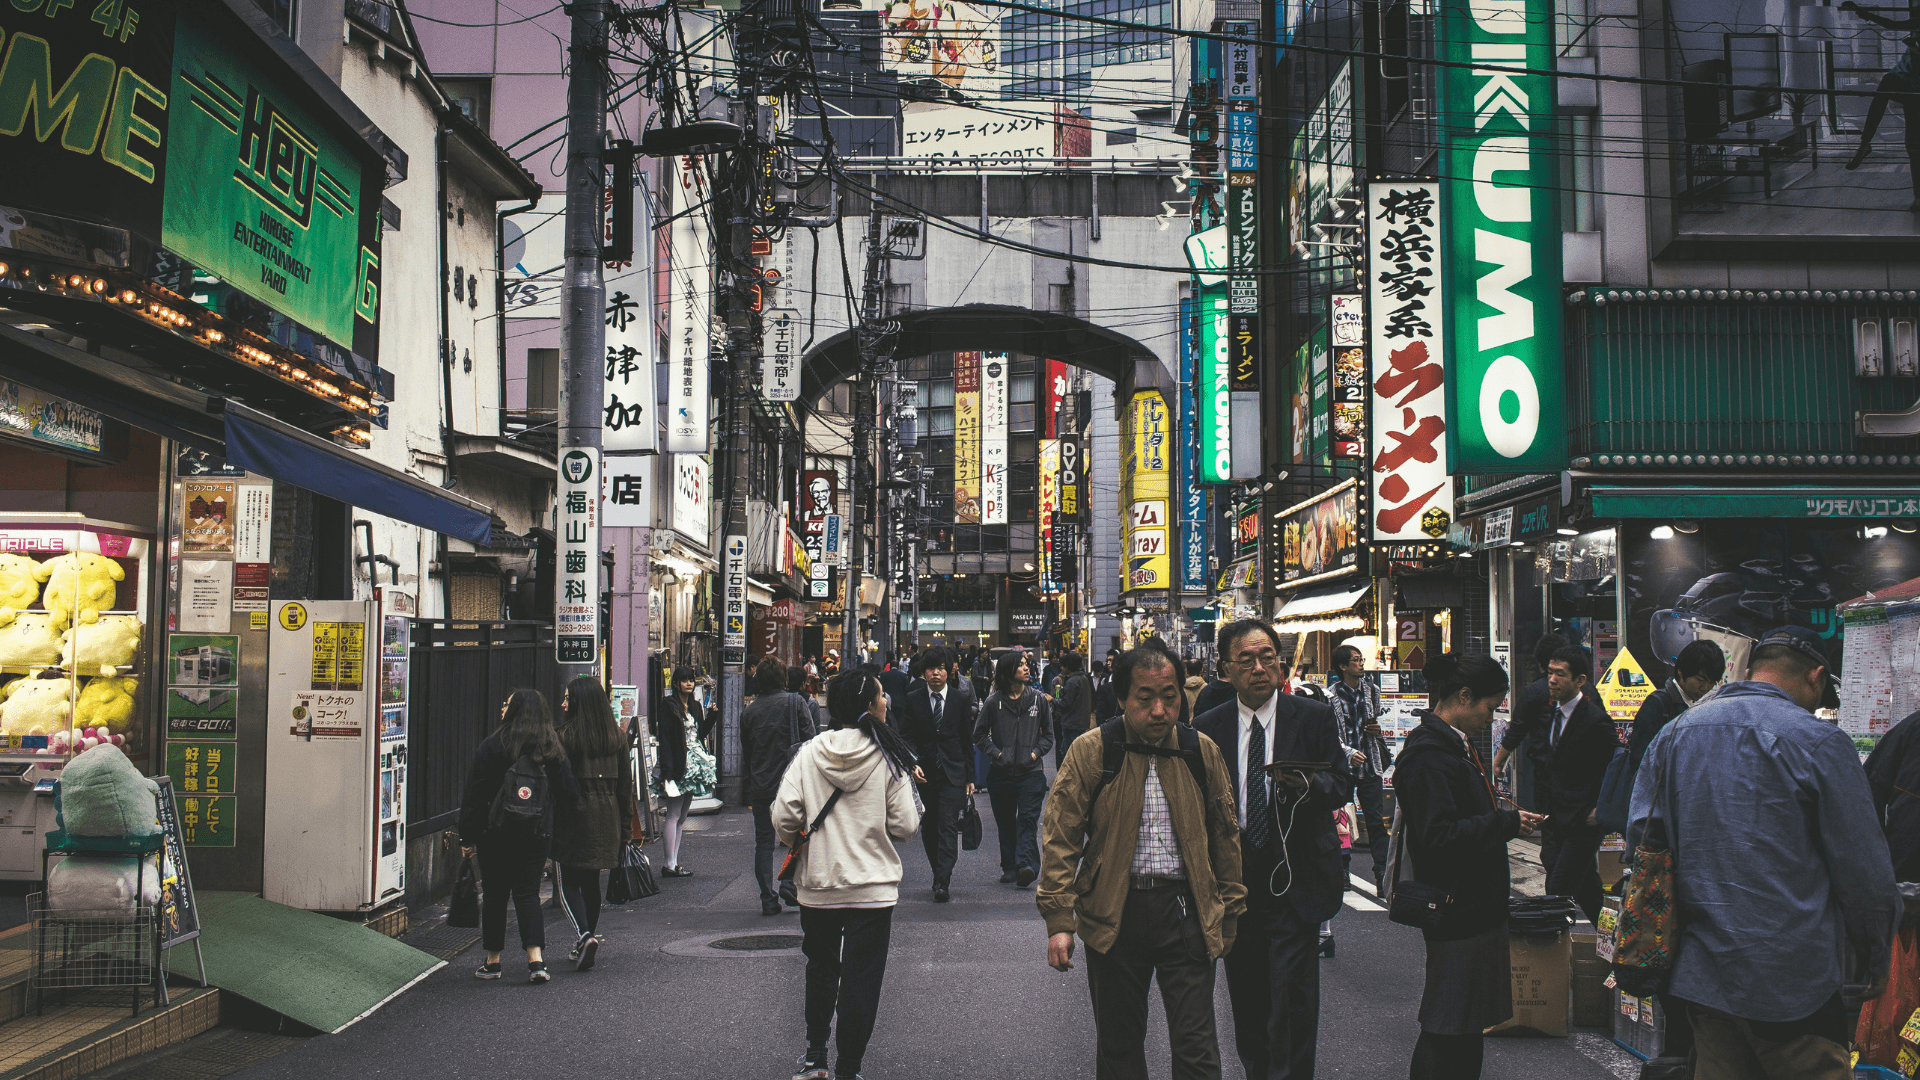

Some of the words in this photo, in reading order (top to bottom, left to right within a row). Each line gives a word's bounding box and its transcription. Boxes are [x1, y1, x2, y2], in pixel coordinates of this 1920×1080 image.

[0, 26, 167, 184] ME
[1231, 85, 1252, 96] 6F
[905, 116, 1045, 144] エンターテインメント
[236, 83, 318, 231] Hey
[258, 209, 295, 249] HIROSE
[233, 220, 312, 285] ENTERTAINMENT
[260, 263, 288, 296] YARD
[604, 290, 645, 433] 赤津加
[774, 328, 789, 378] 千石電商
[1236, 331, 1254, 381] ラーメン
[675, 427, 699, 435] IOSYS
[1149, 398, 1164, 470] トレーダー2
[570, 461, 582, 474] 歯
[186, 484, 234, 493] このフロアーは
[610, 474, 642, 505] 店
[1806, 498, 1920, 516] ツクモパソコン本
[806, 535, 823, 548] 2,3
[807, 522, 824, 532] KF
[564, 490, 588, 604] 福山歯科
[727, 558, 743, 614] 千石電商
[558, 605, 594, 614] ラジオ会館よこ
[765, 605, 789, 618] ¥200
[563, 640, 588, 649] 外神田
[564, 650, 589, 659] 1-10
[316, 709, 348, 720] コーク!
[317, 695, 355, 706] トクホの
[184, 746, 200, 843] 好評稼働中!!
[206, 748, 222, 834] 当フロアにて
